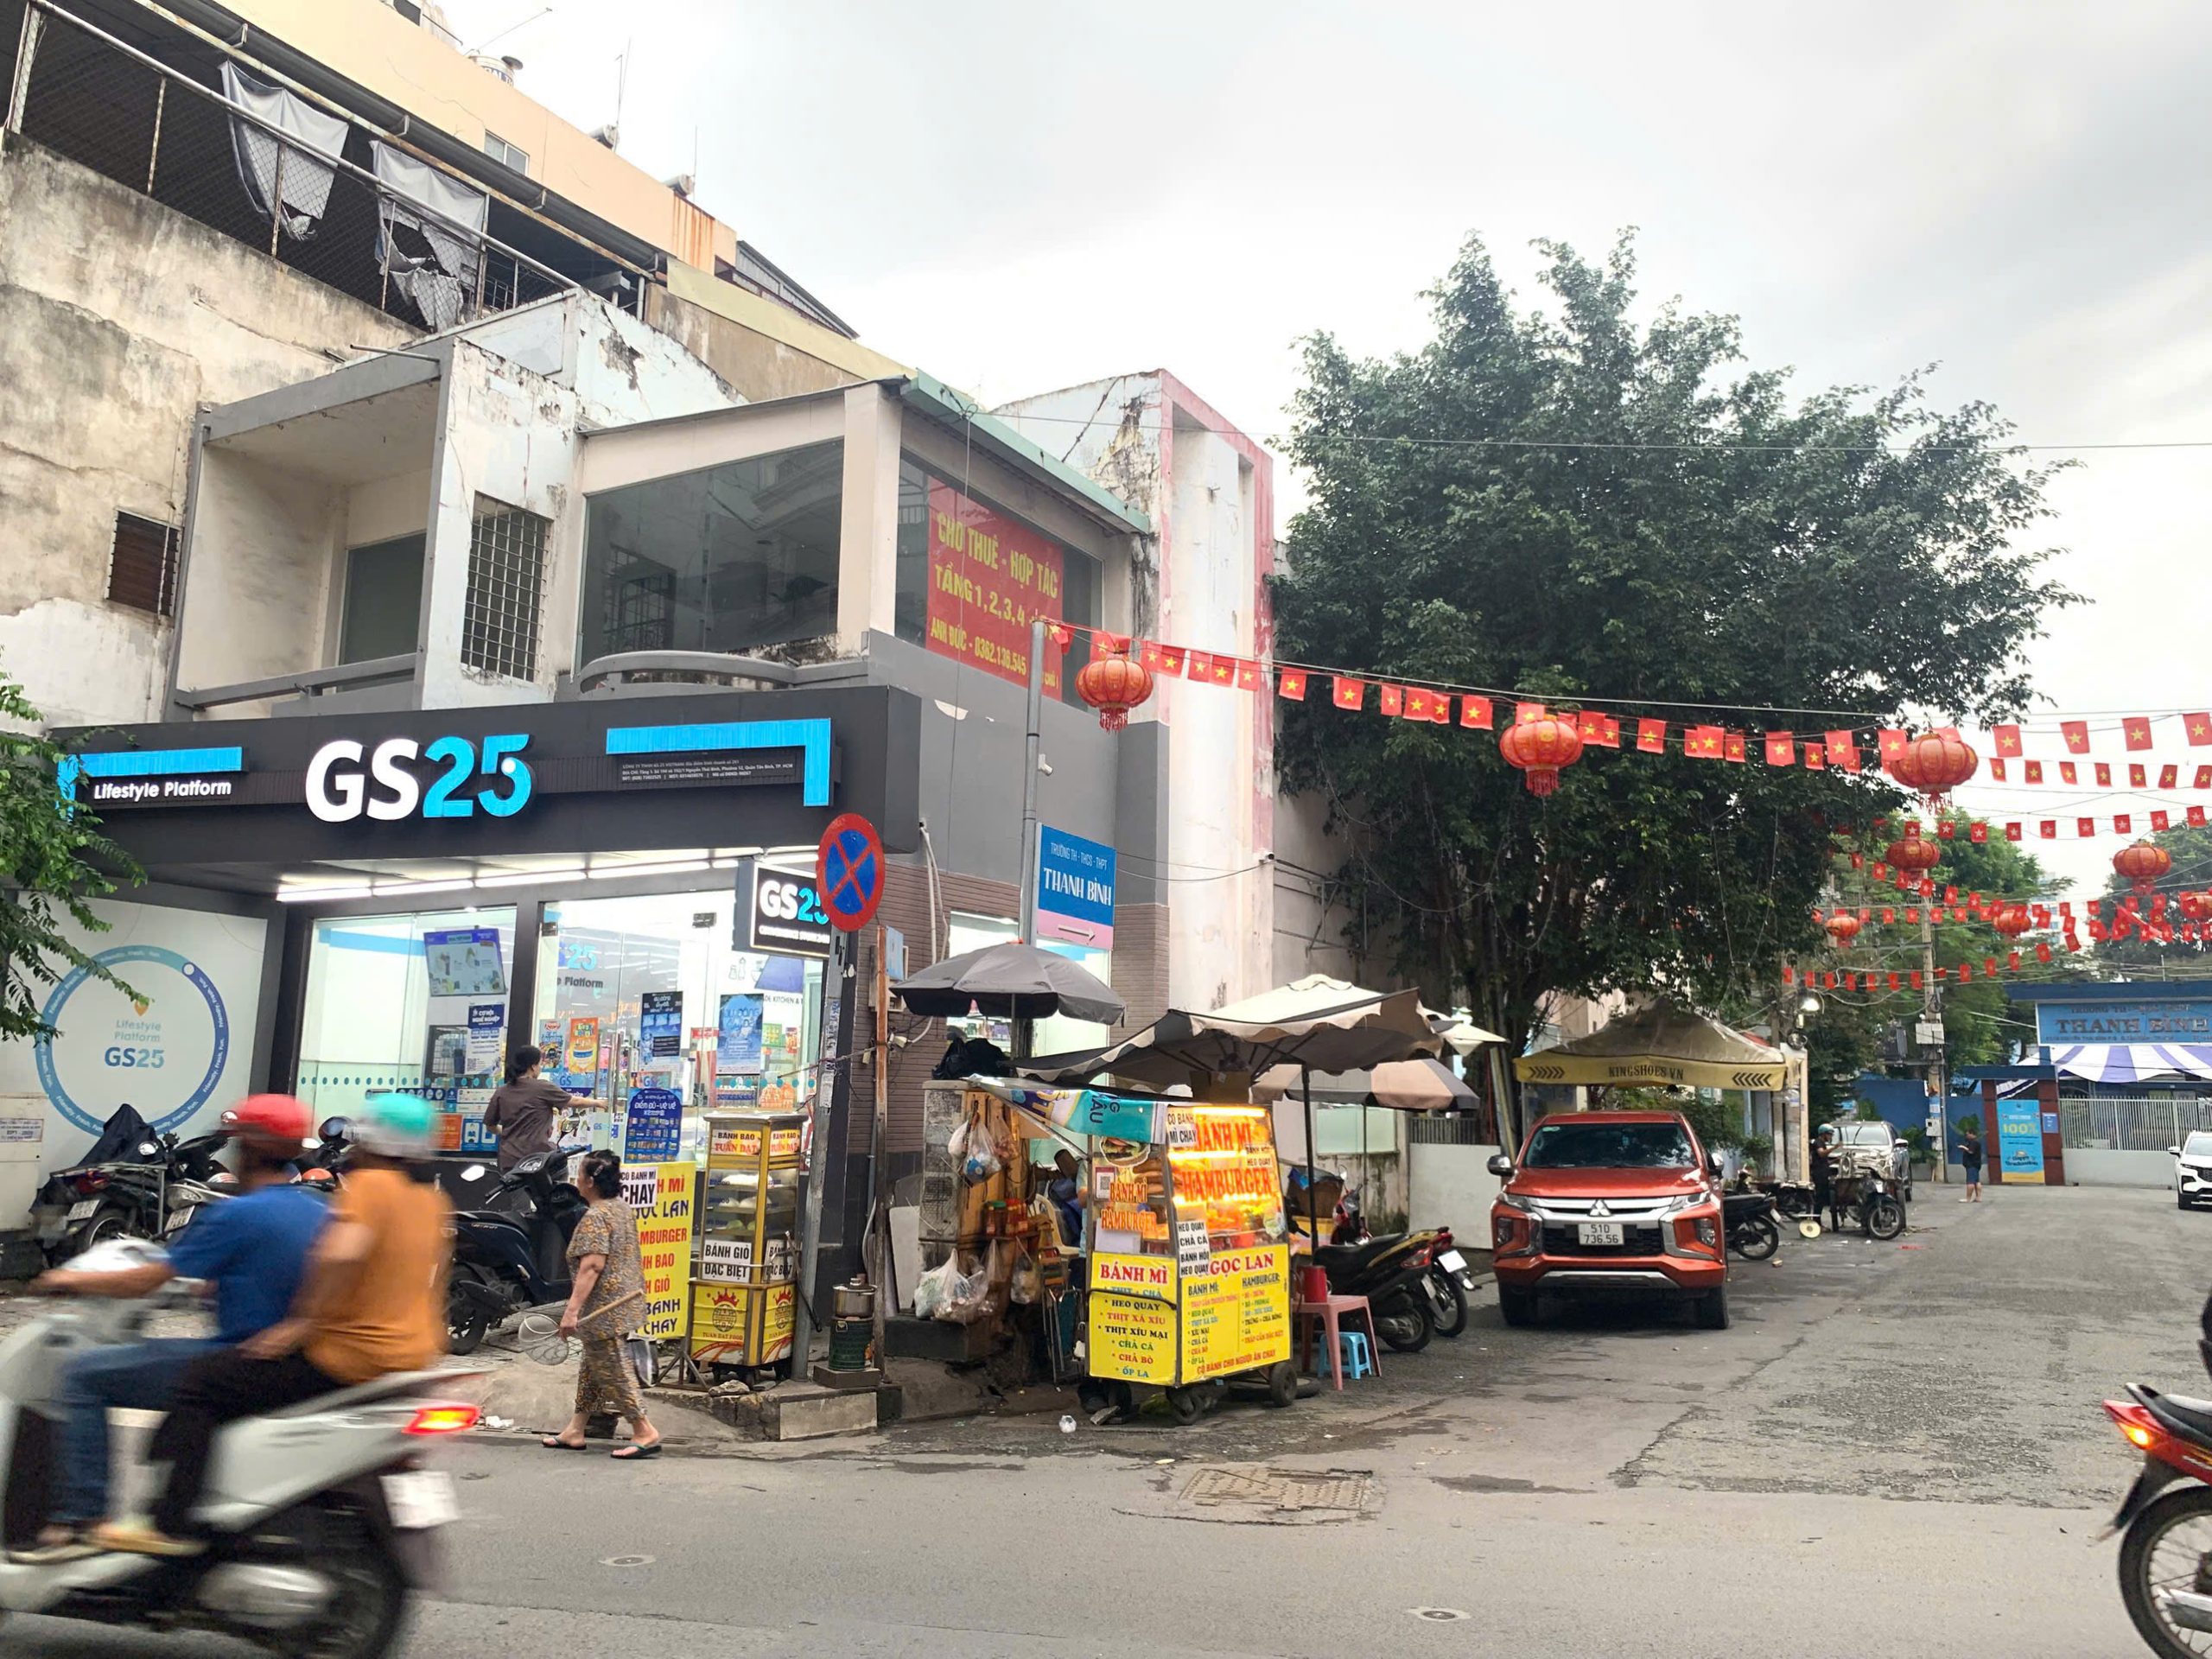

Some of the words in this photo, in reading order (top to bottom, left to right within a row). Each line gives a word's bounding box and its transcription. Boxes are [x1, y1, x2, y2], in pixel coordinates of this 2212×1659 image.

[937, 512, 963, 552] CHO
[935, 561, 973, 603] TẦNG
[305, 733, 534, 823] GS25
[93, 781, 160, 802] Lifestyle
[164, 780, 232, 797] Platform
[1043, 867, 1084, 899] THANH
[1087, 877, 1112, 906] BÌNH
[564, 976, 604, 988] Platform
[116, 1020, 162, 1032] Lifestyle
[2056, 1017, 2141, 1034] THANH
[2148, 1013, 2210, 1033] BÌNH
[114, 1032, 161, 1042] Platform
[105, 1046, 164, 1069] GS25
[1608, 1065, 1667, 1078] KINGSHOES
[1669, 1067, 1684, 1080] VN
[1169, 1127, 1179, 1143] MÌ
[1179, 1129, 1197, 1144] CHAY
[1182, 1167, 1272, 1202] HAMBURGER
[621, 1184, 655, 1205] CHAY
[663, 1199, 690, 1218] LAN
[1178, 1223, 1190, 1231] HEO
[1190, 1222, 1205, 1230] QUAY
[1590, 1224, 1611, 1234] 51D
[639, 1228, 687, 1246] MBURGER
[1583, 1234, 1619, 1244] 736.56
[705, 1243, 731, 1258] BÁNH
[655, 1252, 675, 1268] BAO
[1210, 1257, 1241, 1278] GỌC
[1245, 1253, 1274, 1270] LAN
[1100, 1262, 1145, 1282] BÁNH
[1149, 1265, 1168, 1284] MÌ
[1181, 1265, 1192, 1275] HEO
[1194, 1264, 1209, 1276] QUAY
[1188, 1282, 1208, 1296] BÁNH
[1111, 1299, 1131, 1307] HEO
[1134, 1300, 1160, 1312] QUAY
[644, 1318, 677, 1335] CHAY
[1107, 1313, 1130, 1323] THỊT
[1148, 1314, 1166, 1325] XÍU
[1105, 1325, 1128, 1337] THỊT
[1130, 1326, 1147, 1337] XÍU
[1149, 1330, 1168, 1340] MẠI
[1118, 1338, 1138, 1350] CHẢ
[1118, 1352, 1138, 1363] CHẢ
[1122, 1365, 1135, 1376] ỐP
[1137, 1370, 1150, 1379] LA
